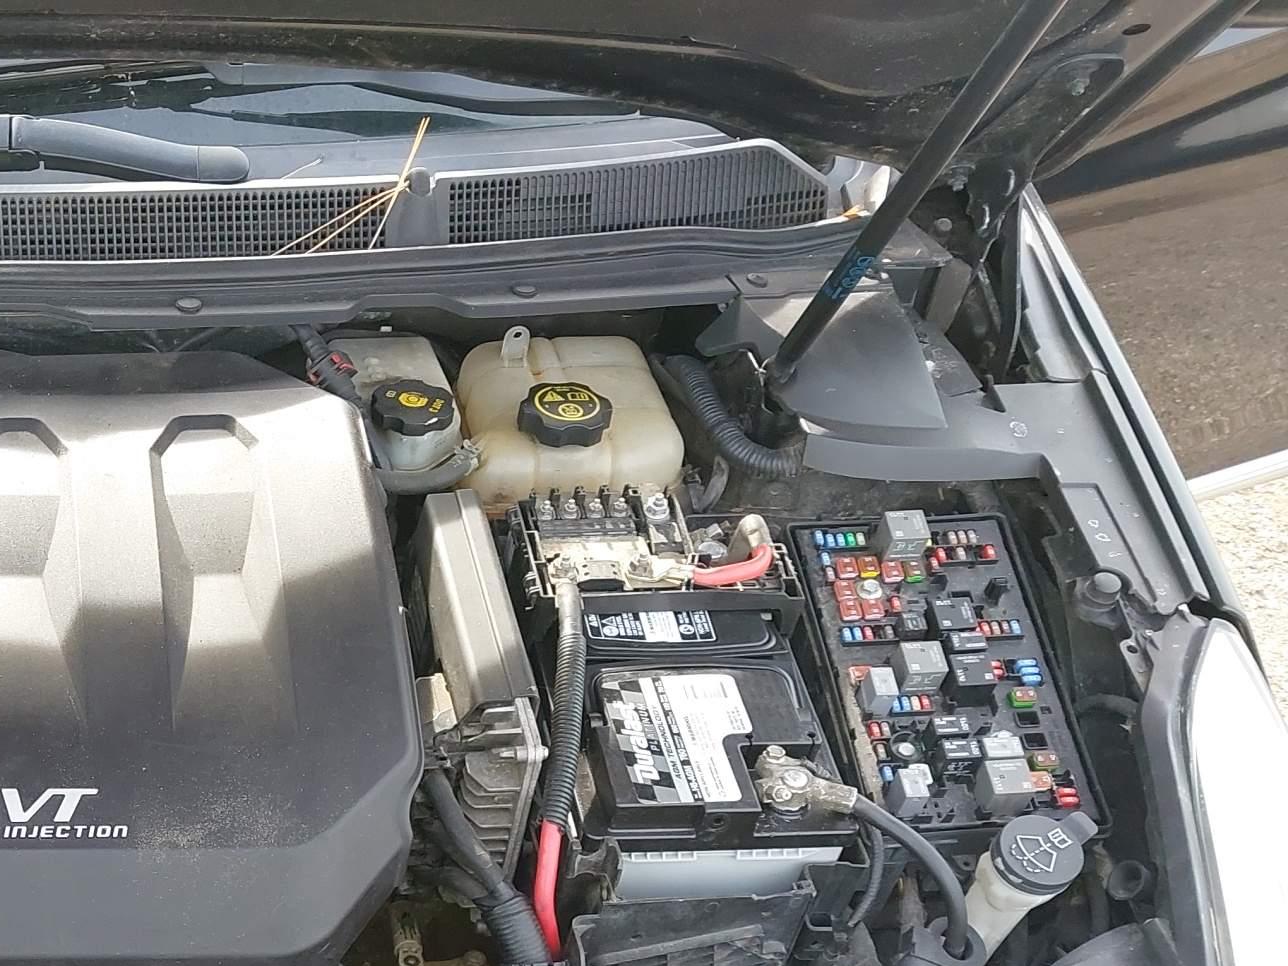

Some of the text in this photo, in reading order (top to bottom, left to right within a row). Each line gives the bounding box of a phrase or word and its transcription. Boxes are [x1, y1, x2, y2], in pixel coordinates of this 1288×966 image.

[612, 700, 660, 784] Duralast
[635, 703, 661, 753] PLATINUM
[3, 825, 128, 839] INJECTION
